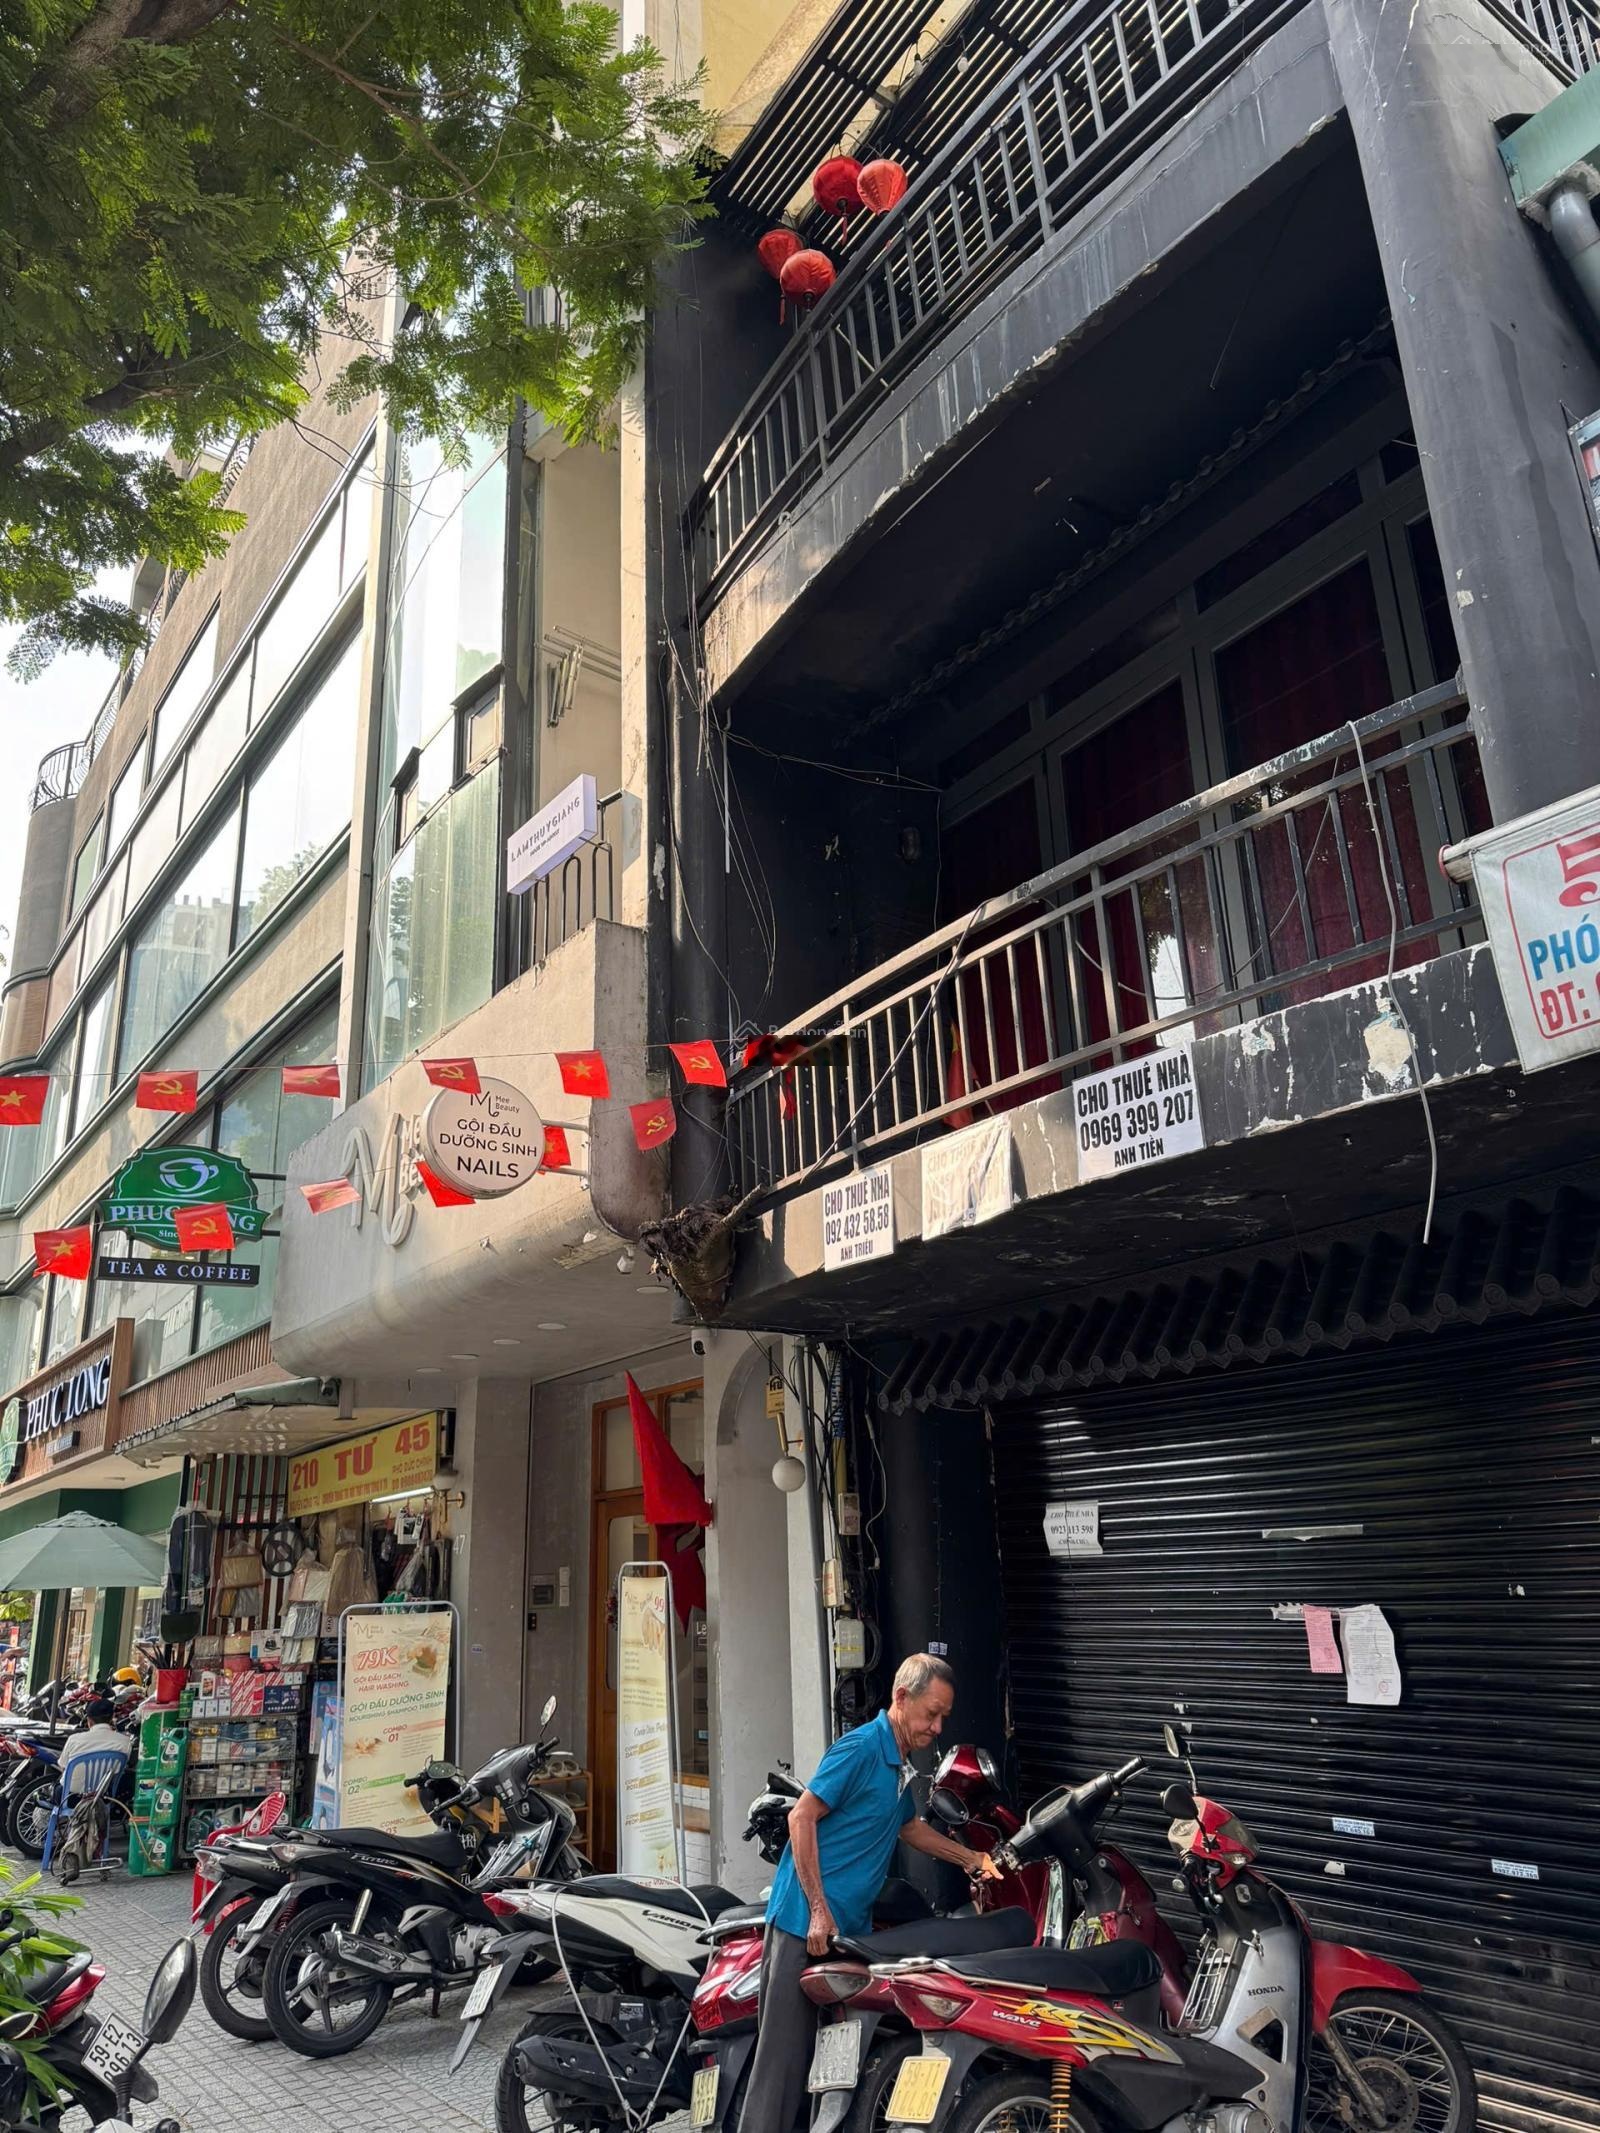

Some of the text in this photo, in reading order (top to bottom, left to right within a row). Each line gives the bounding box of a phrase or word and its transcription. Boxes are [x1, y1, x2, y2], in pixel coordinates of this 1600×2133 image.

[1540, 981, 1591, 1032] ĐT:
[1077, 1050, 1191, 1117] CHO THUÊ NHÀ
[495, 1102, 520, 1114] Beauty
[457, 1118, 485, 1135] GỘI
[1080, 1089, 1194, 1151] 0969 399 207
[439, 1132, 538, 1158] DƯỠNG SINH
[457, 1156, 520, 1179] NAILS
[1114, 1146, 1136, 1168] ANH
[825, 1188, 843, 1217] CHO
[871, 1169, 890, 1203] NHÀ
[825, 1203, 889, 1245] 092 432 58.58
[841, 1245, 853, 1261] ANH
[108, 1260, 251, 1280] TEA & COFFEE
[64, 1355, 110, 1422] LONG
[292, 1458, 319, 1492] 210
[334, 1436, 378, 1481] TƯ
[395, 1420, 430, 1455] 45
[453, 1534, 466, 1555] 47
[357, 1645, 399, 1671] 79K
[358, 1680, 410, 1693] HAIR WASHING
[425, 1689, 445, 1700] SINH
[382, 1723, 408, 1735] COMBO
[388, 1732, 399, 1743] 01
[347, 1785, 360, 1796] 02
[1247, 1985, 1285, 1996] HONDA
[992, 2010, 1041, 2028] wave
